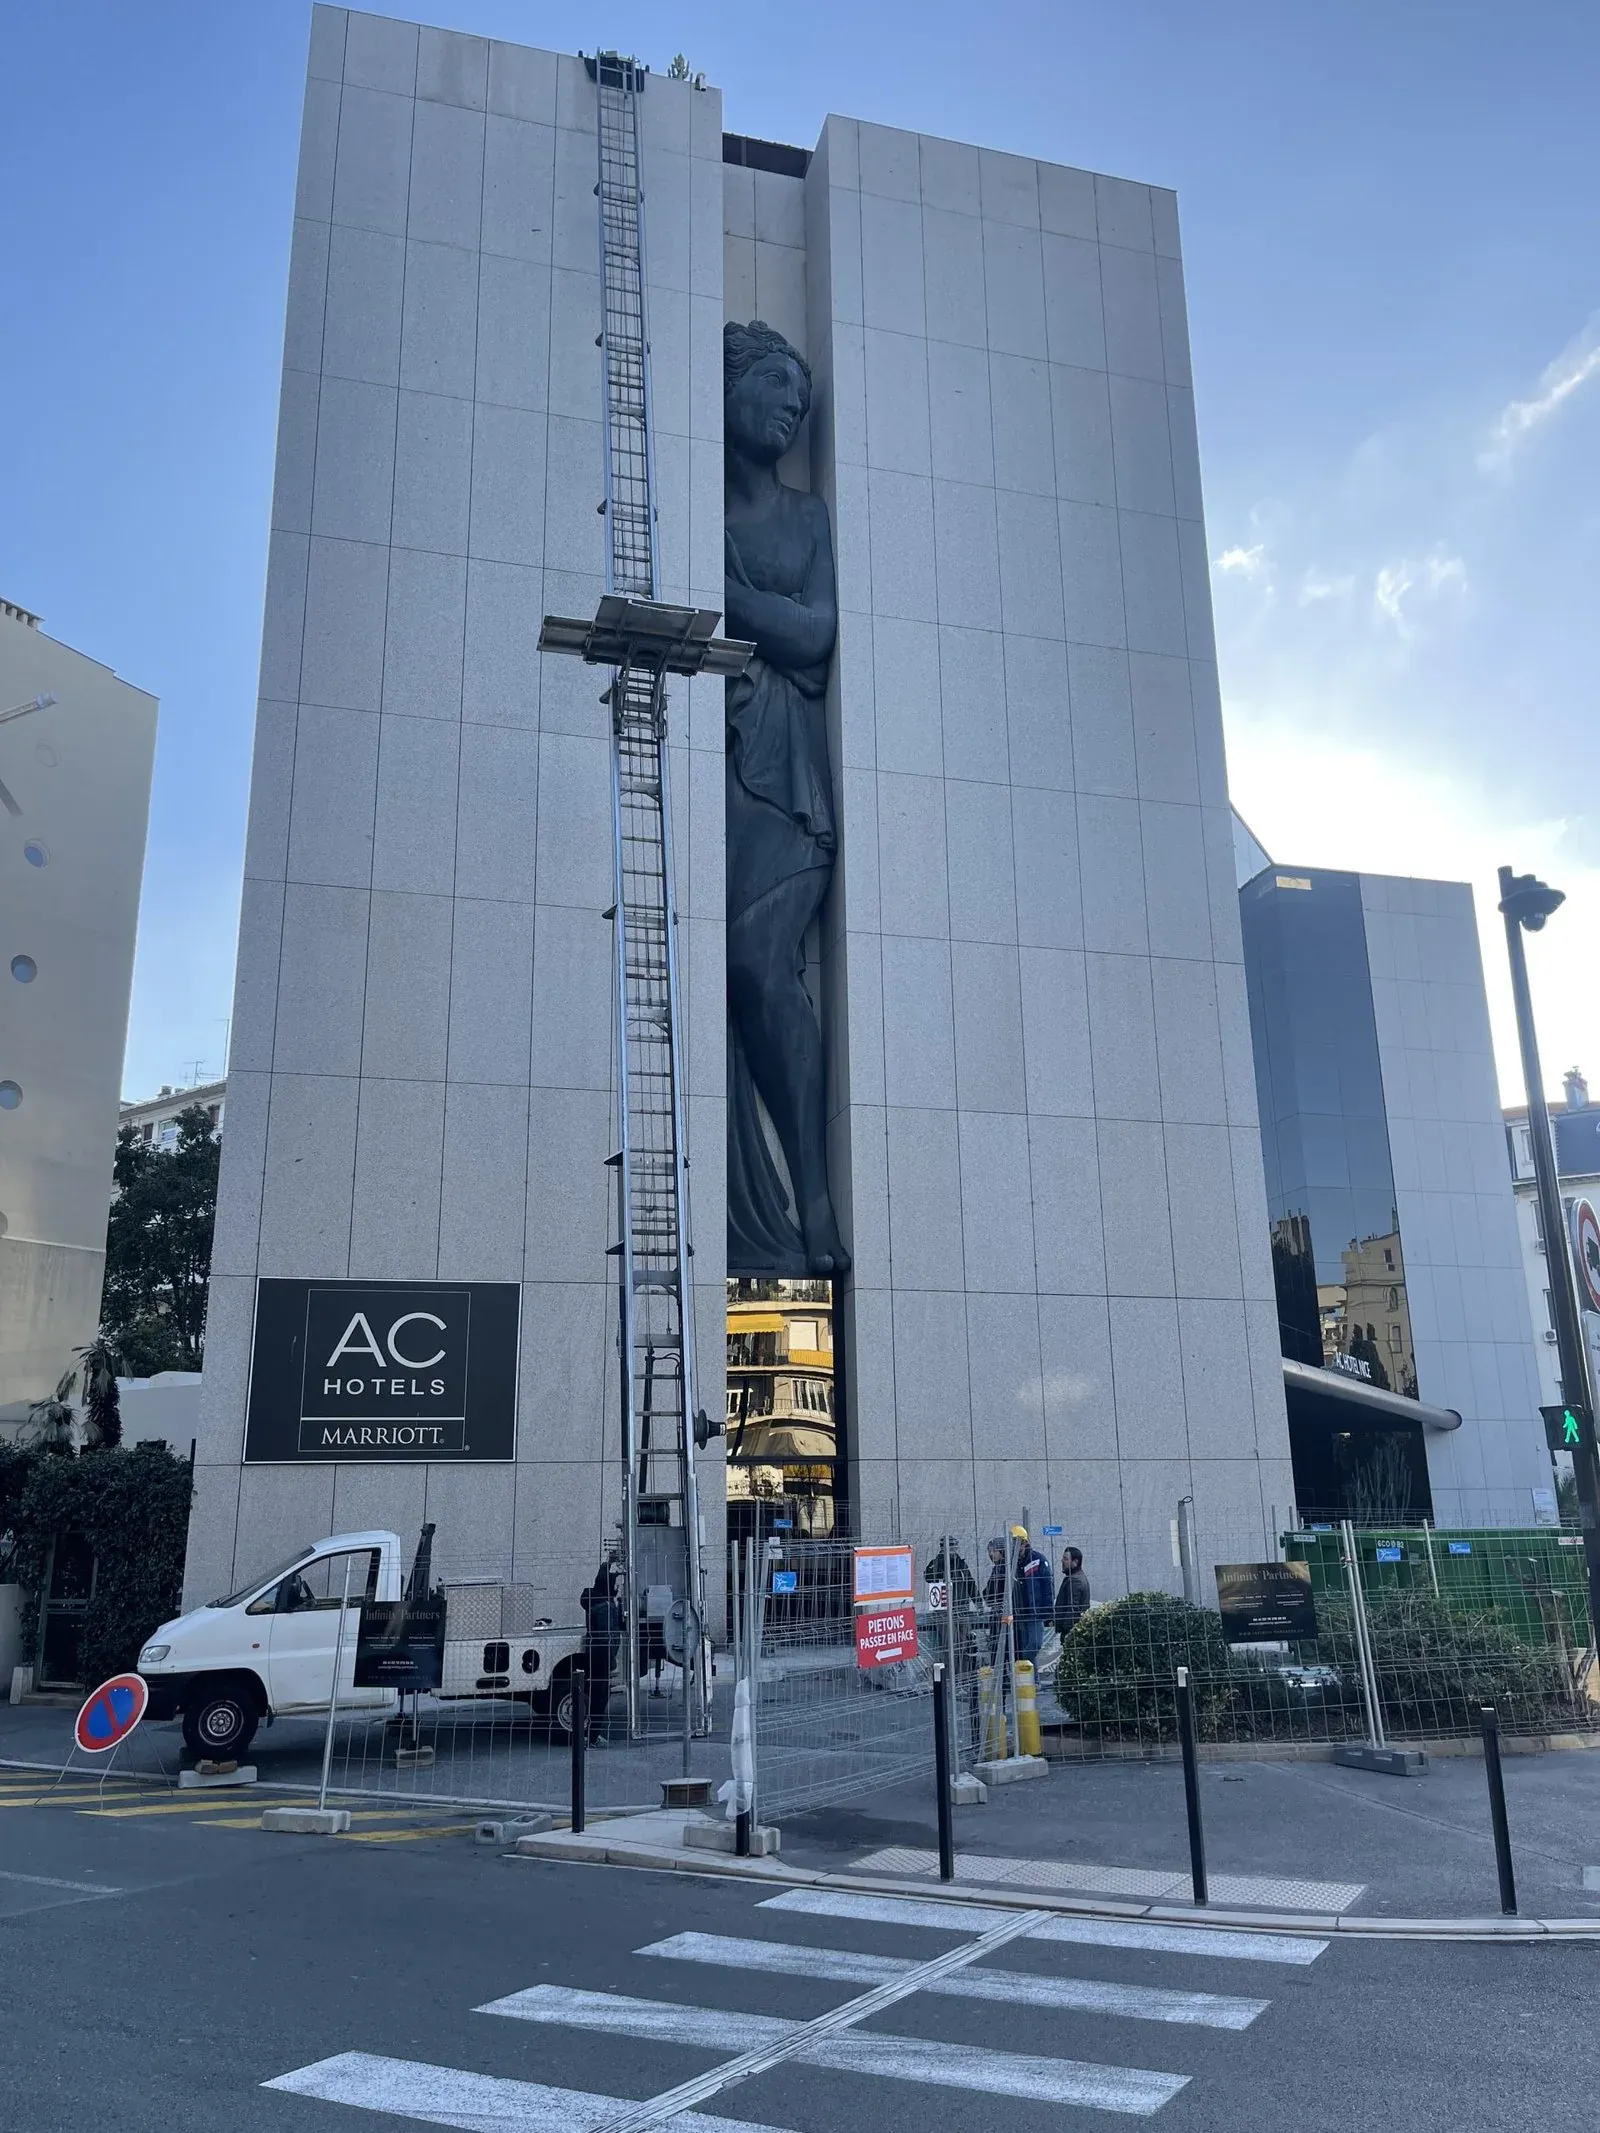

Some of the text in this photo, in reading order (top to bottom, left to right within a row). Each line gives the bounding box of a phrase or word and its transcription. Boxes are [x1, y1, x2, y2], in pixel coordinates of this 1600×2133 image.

[326, 1312, 447, 1368] AC
[323, 1378, 445, 1395] HOTELS
[321, 1427, 443, 1445] MARRIOTT
[1222, 1571, 1259, 1584] Infinity
[365, 1608, 440, 1622] Infinity Partners
[868, 1615, 904, 1634] PIETONS
[860, 1629, 914, 1650] PASSEZ EN FACE
